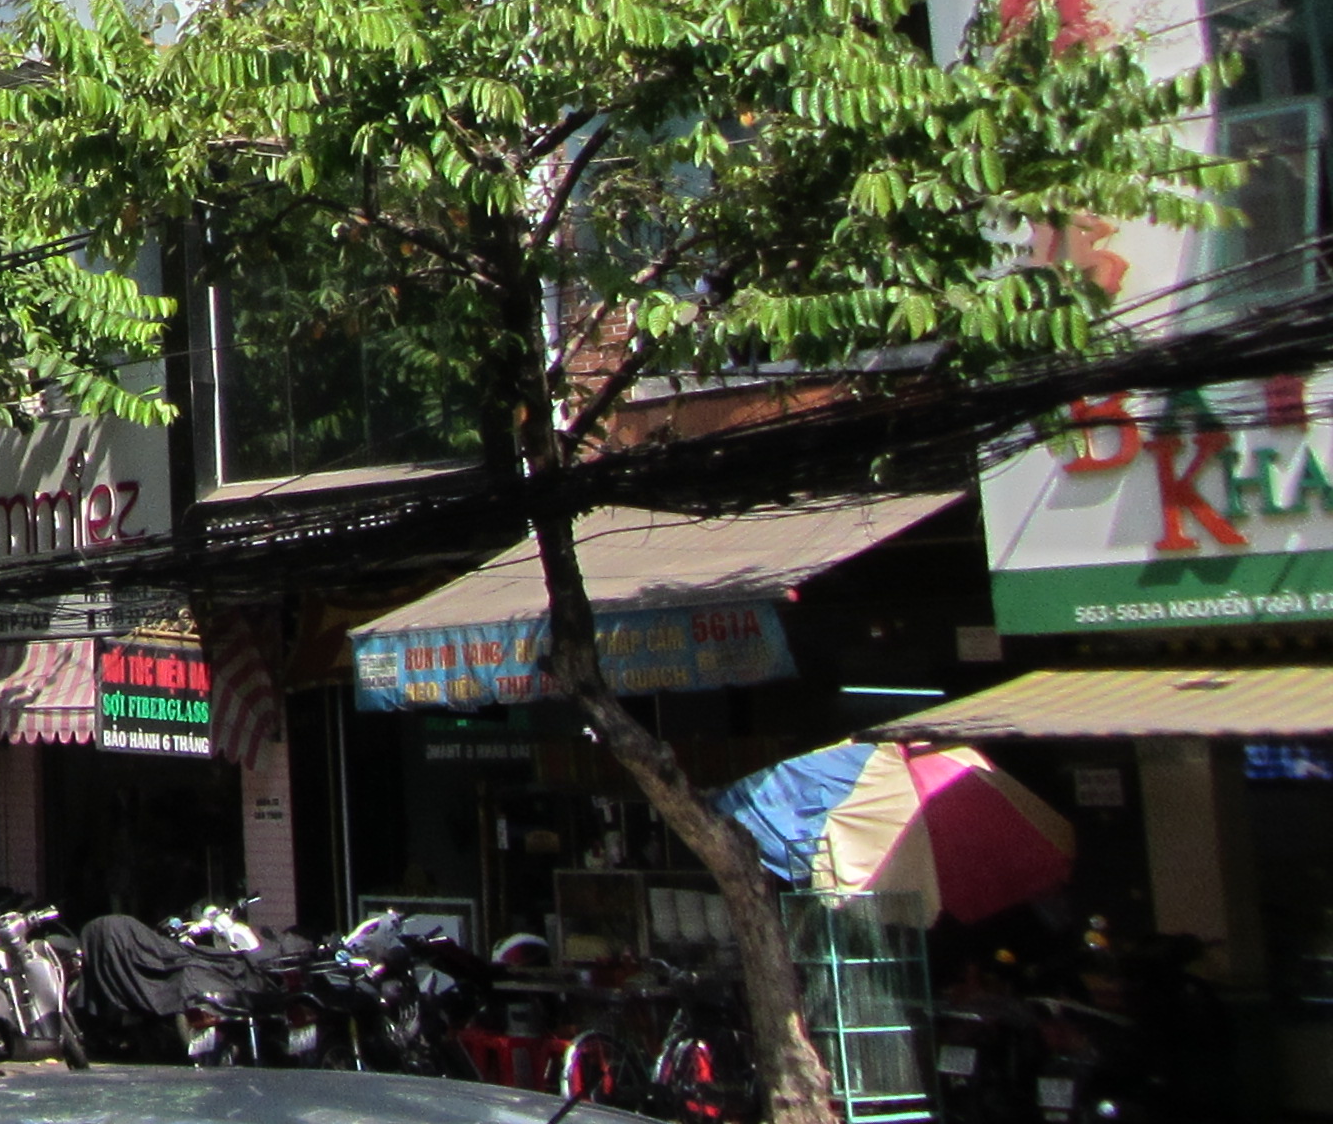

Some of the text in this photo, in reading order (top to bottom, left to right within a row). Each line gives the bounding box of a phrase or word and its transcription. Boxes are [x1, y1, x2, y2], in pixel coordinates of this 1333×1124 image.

[692, 609, 762, 644] 561A
[128, 693, 210, 725] FIBERGLASS
[103, 723, 210, 755] BẢO HÀNH 6 THÁNG
